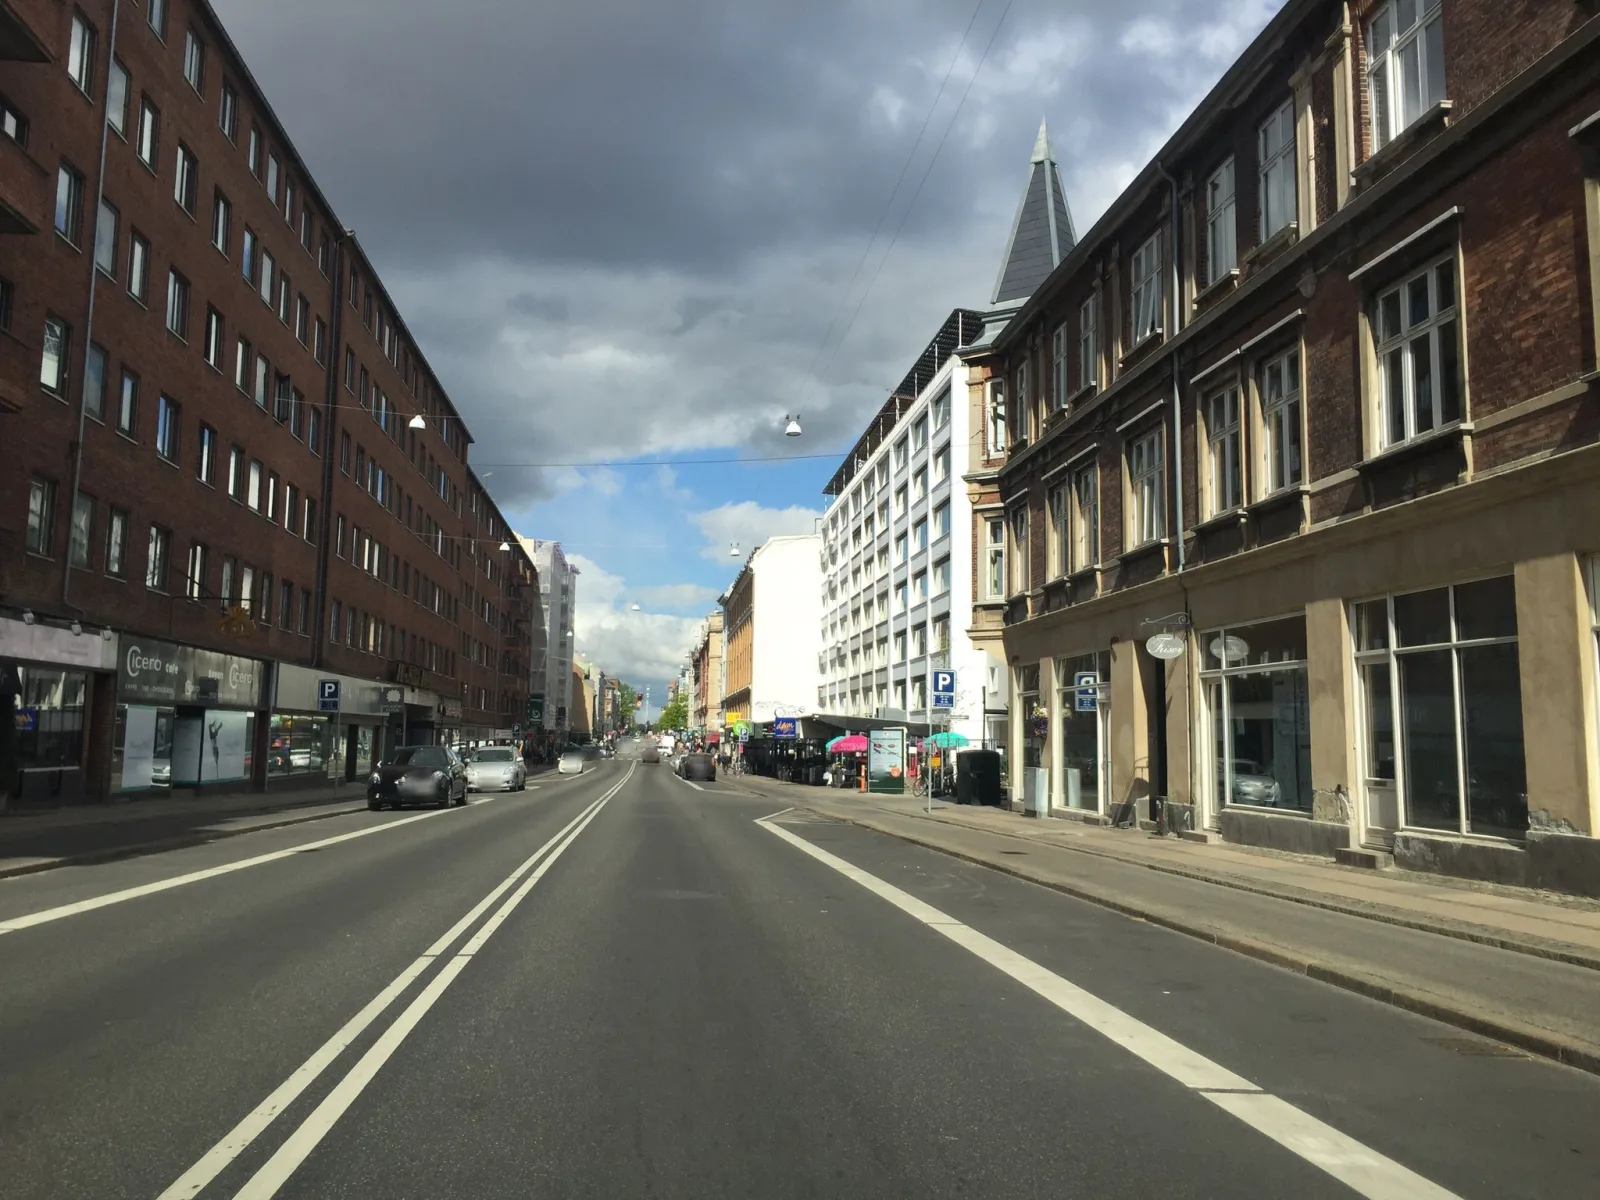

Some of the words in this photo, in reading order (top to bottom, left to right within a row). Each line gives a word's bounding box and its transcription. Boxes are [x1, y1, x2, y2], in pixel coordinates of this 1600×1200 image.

[127, 645, 162, 677] Cicero
[229, 663, 253, 689] Cicero
[938, 673, 951, 691] P
[324, 683, 336, 697] P
